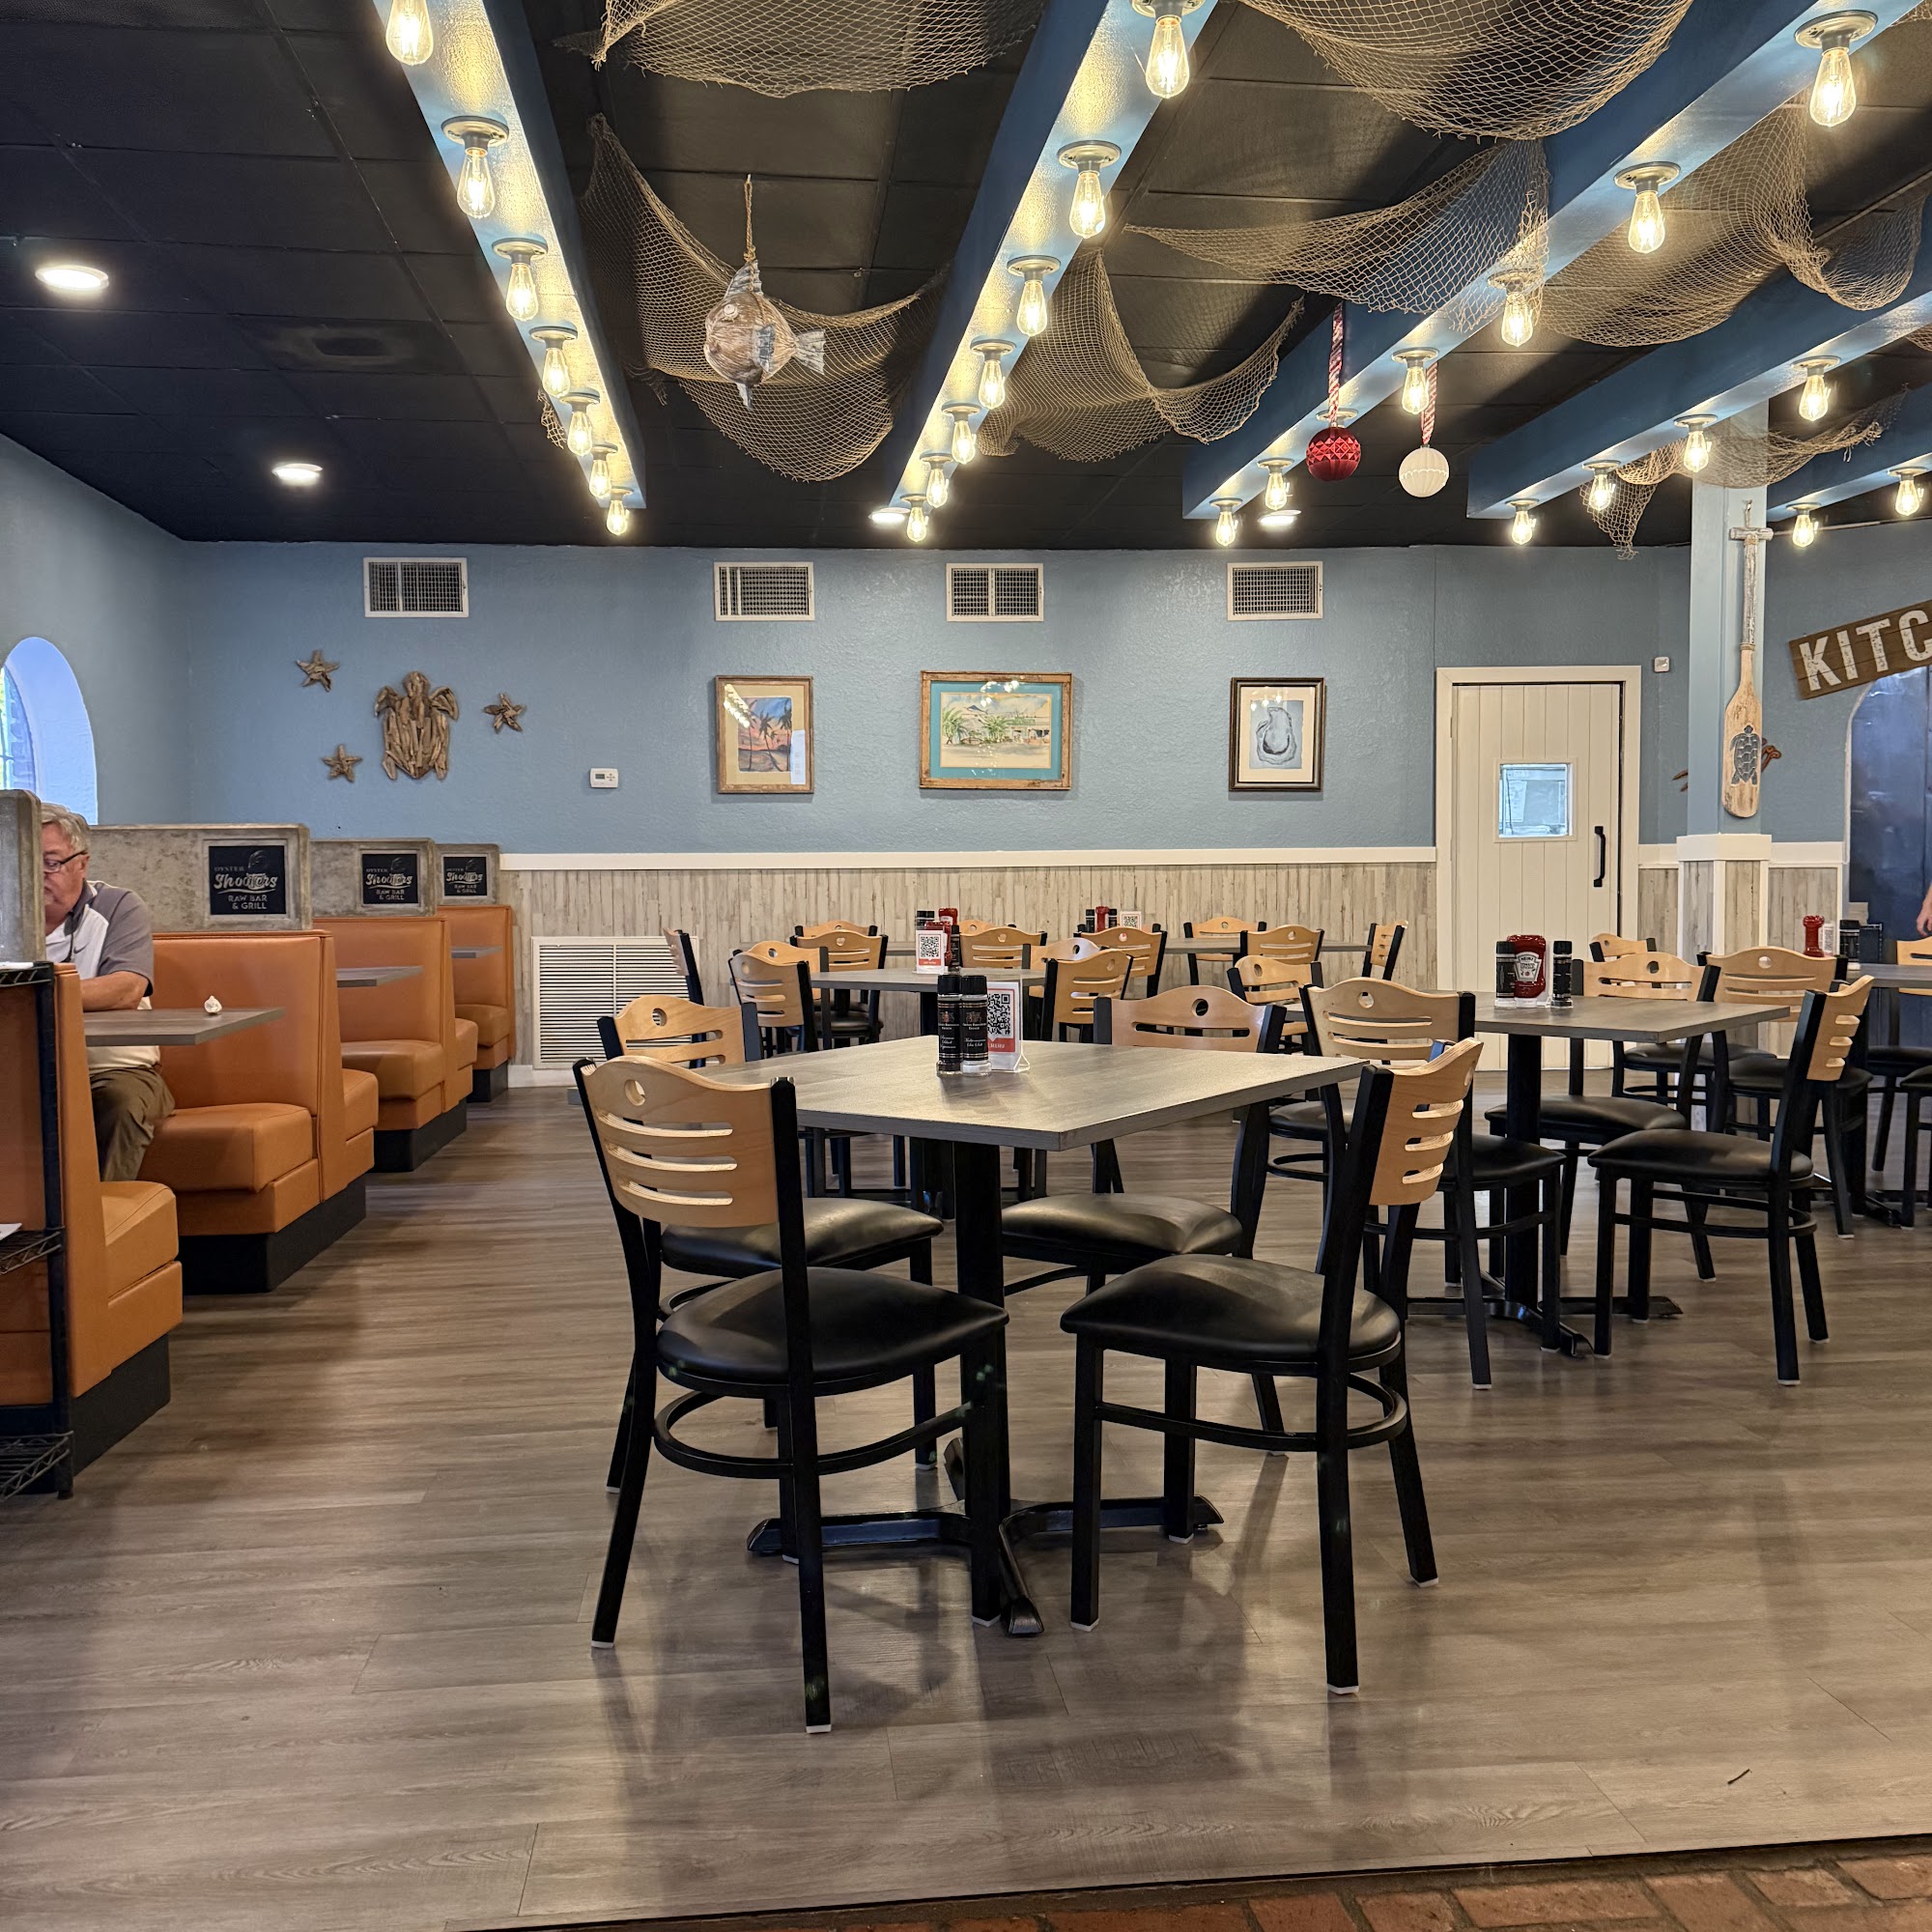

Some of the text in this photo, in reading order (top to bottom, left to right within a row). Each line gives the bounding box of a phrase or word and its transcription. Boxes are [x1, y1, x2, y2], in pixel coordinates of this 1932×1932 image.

[1799, 610, 1932, 692] KITC
[213, 872, 278, 890] Shooters
[249, 894, 268, 902] BAR
[241, 901, 268, 910] GRILL
